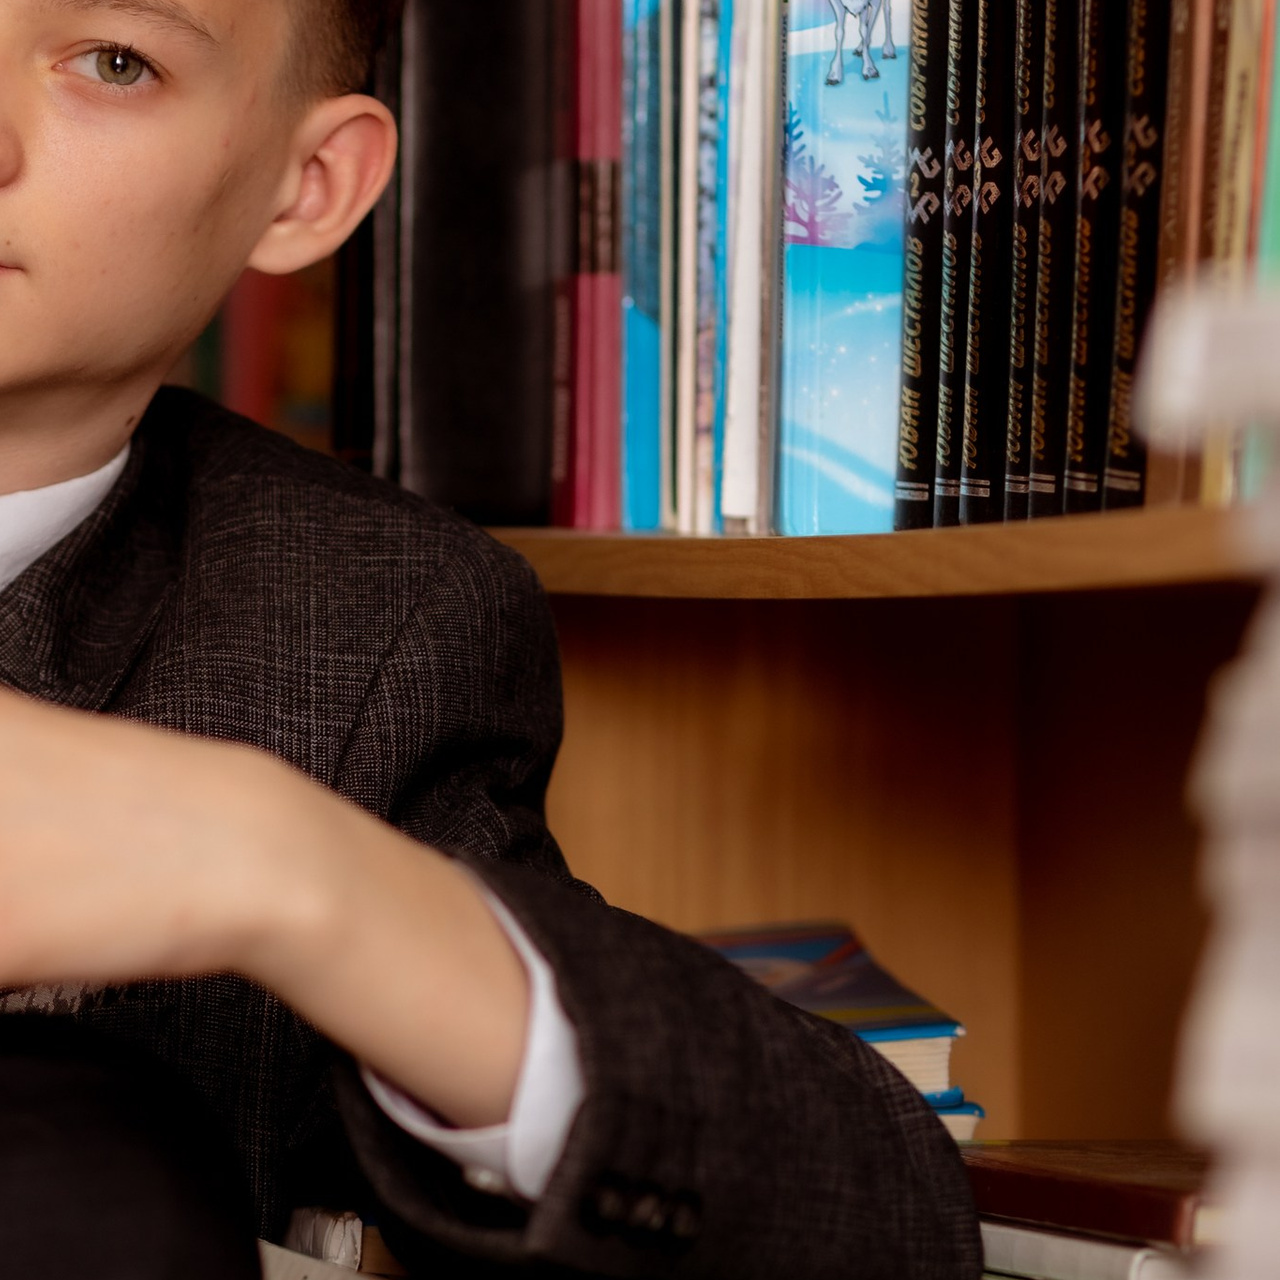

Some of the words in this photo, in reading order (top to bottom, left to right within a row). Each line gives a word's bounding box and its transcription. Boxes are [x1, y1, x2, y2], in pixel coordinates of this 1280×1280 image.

[902, 234, 924, 378] ШЕСТАЛОВ
[938, 230, 957, 374] ШЕСТАЛОВ
[965, 231, 982, 375] ШЕСТАЛОВ
[1009, 222, 1028, 369] ШЕСТАЛОВ
[1033, 216, 1052, 366] ШЕСТАЛОВ
[898, 385, 920, 470] ЮВАН
[935, 382, 953, 468] ЮВАН
[961, 383, 979, 470] ЮВАН
[1006, 377, 1024, 464] ЮВАН
[1029, 373, 1047, 461] ЮВАН
